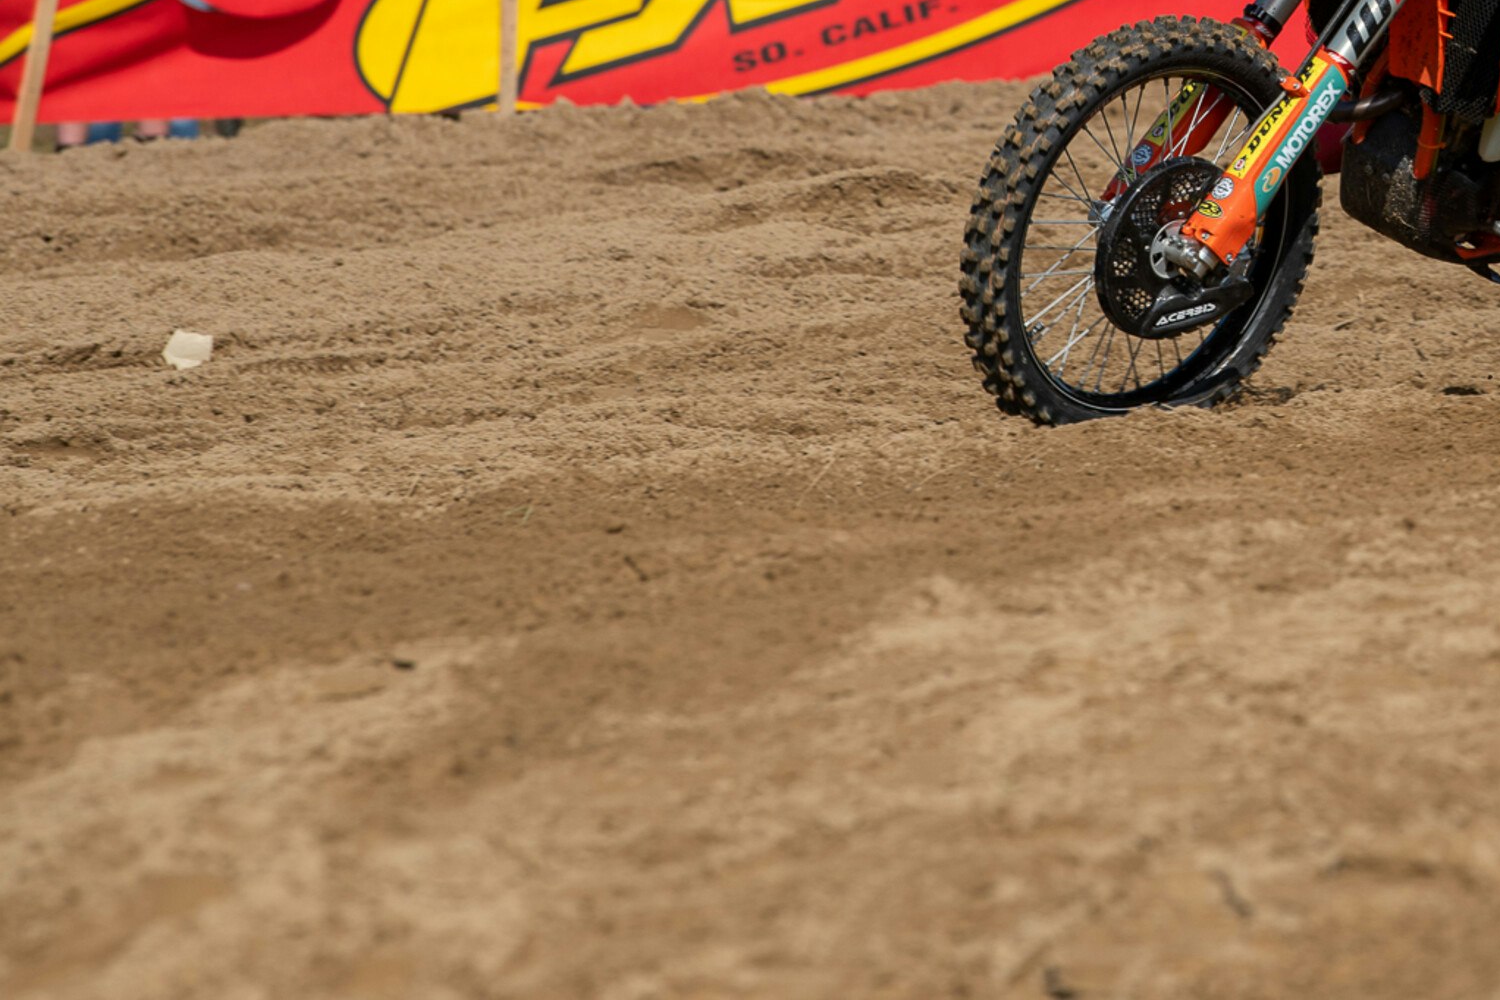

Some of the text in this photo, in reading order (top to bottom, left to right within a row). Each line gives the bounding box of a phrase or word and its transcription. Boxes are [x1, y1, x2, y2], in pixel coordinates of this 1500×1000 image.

[733, 40, 804, 73] SO.
[1274, 80, 1342, 174] MOTOREX
[1155, 302, 1217, 328] ACERBIS
